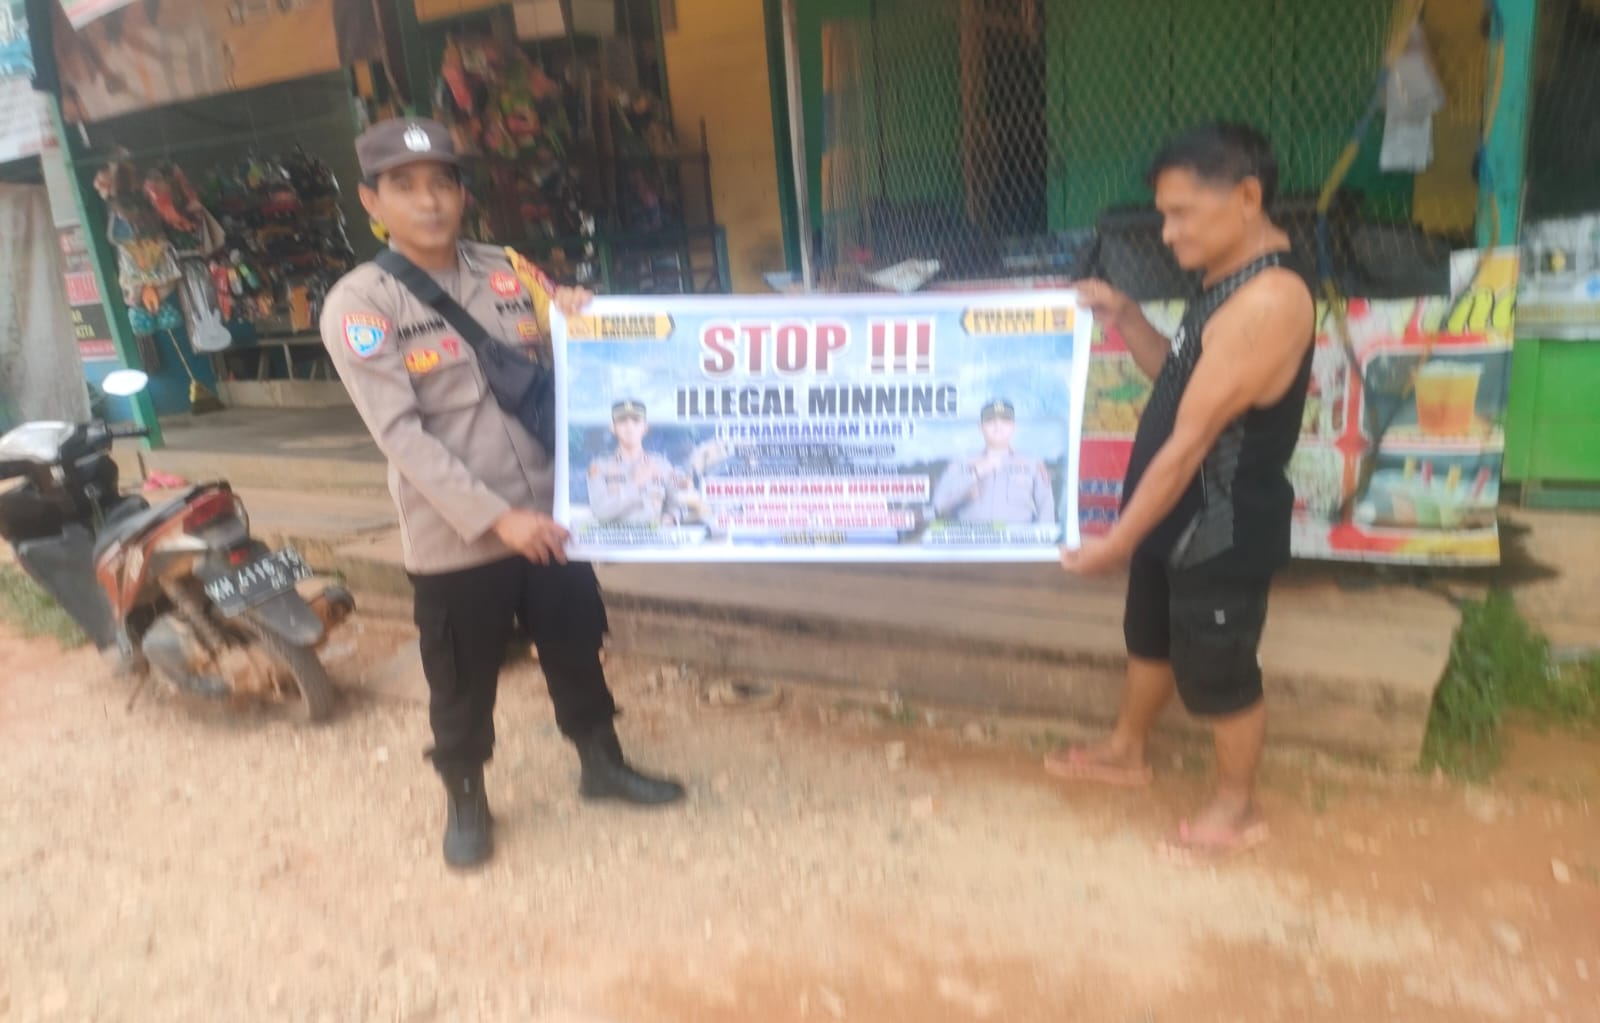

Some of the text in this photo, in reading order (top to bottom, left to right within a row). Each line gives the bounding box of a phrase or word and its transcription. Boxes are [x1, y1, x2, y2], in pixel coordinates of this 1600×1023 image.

[703, 321, 931, 374] STOP !!!
[677, 385, 958, 416] ILLEGAL MINNING
[728, 421, 860, 439] PENAMBANGAN
[706, 484, 766, 497] DENGAN
